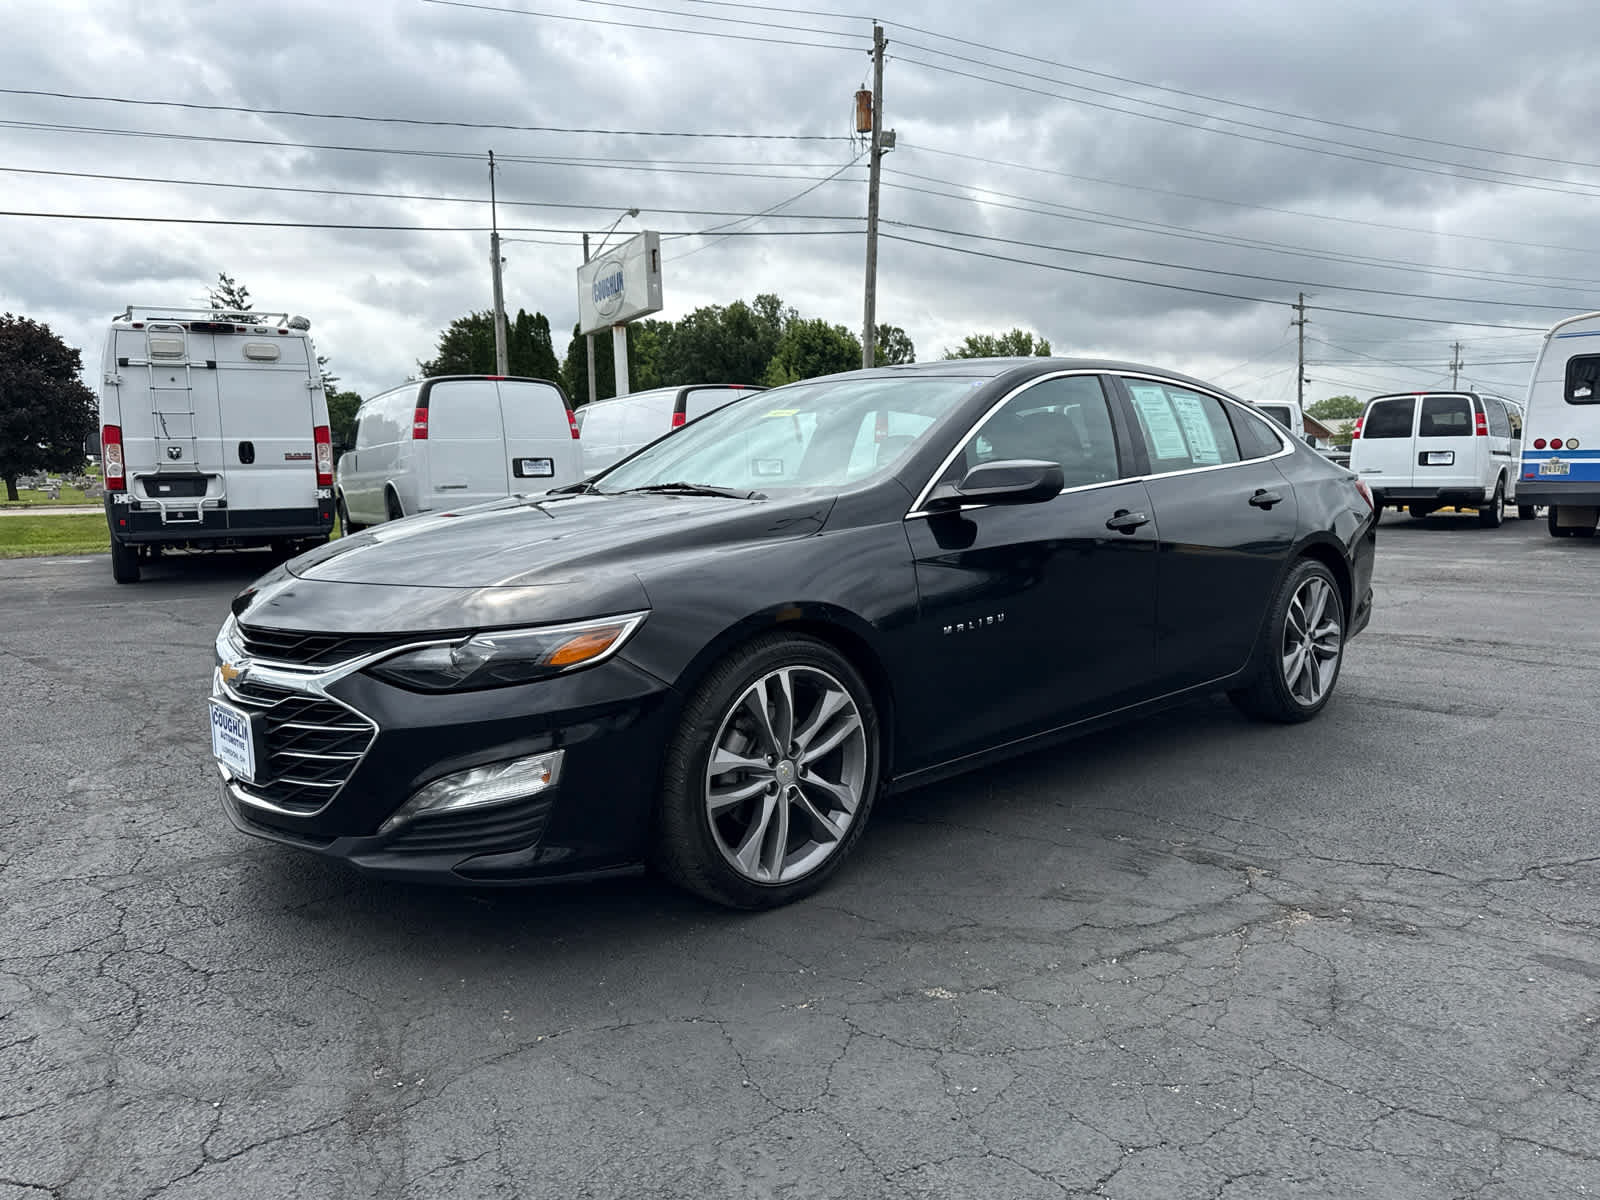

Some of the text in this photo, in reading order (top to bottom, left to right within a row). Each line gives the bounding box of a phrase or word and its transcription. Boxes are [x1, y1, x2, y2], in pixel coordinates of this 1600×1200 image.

[593, 271, 624, 303] COUGHLIN
[943, 613, 1004, 634] MALIBU
[213, 711, 248, 740] COUGHLIN
